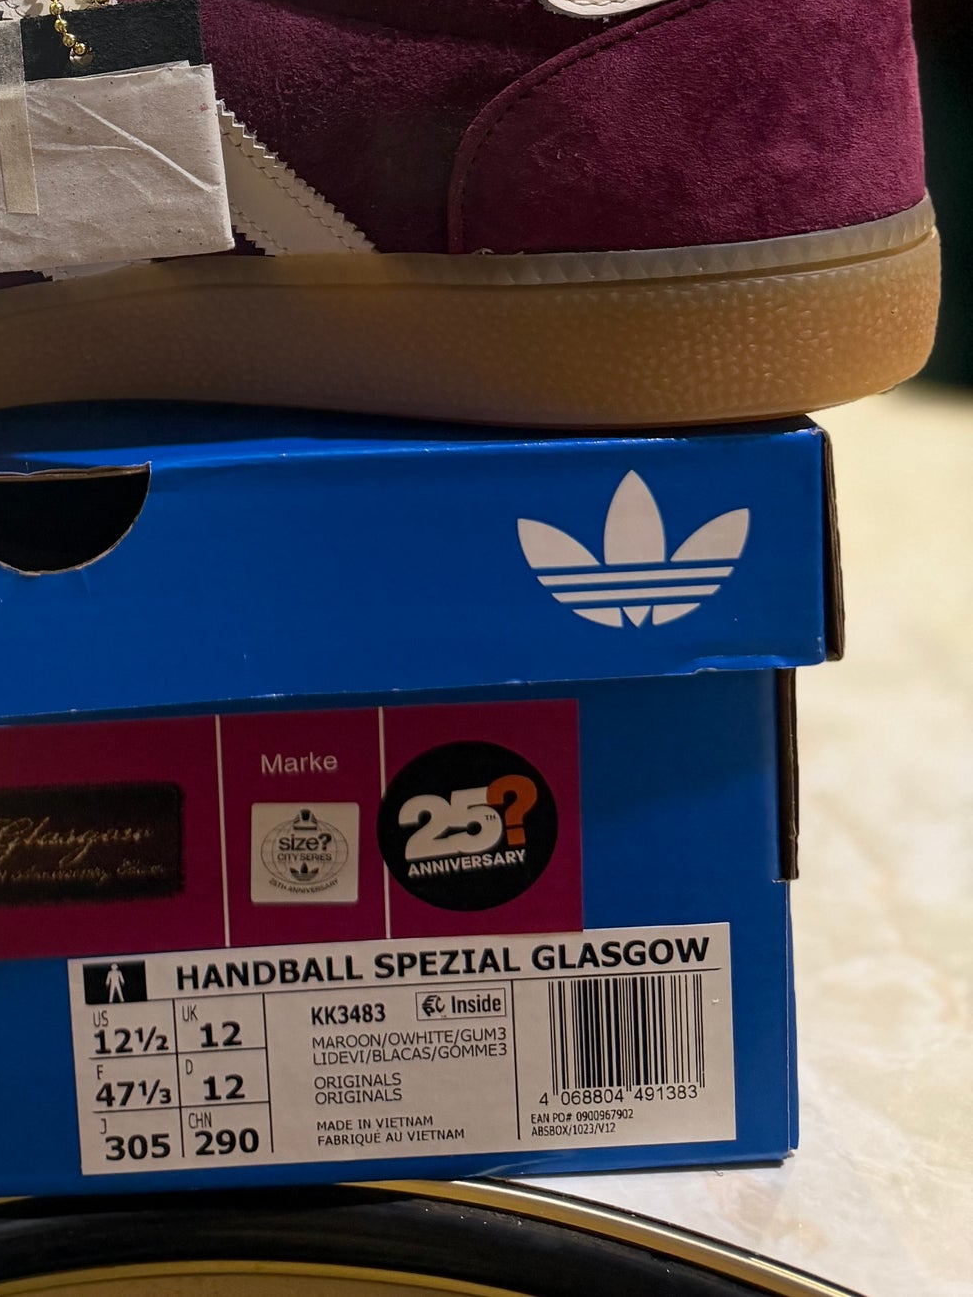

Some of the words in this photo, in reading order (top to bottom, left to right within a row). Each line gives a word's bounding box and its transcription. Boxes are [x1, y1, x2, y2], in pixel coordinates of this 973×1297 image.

[260, 751, 338, 775] Marke
[278, 832, 332, 852] size?
[277, 853, 300, 861] CITY
[300, 853, 332, 861] SERIES
[408, 849, 526, 877] ANNIVERSARY
[288, 877, 339, 894] ANNIVERSARY
[176, 955, 363, 991] HANDBALL
[374, 947, 520, 979] SPEZIAL
[531, 937, 709, 971] GLASGOW
[451, 994, 501, 1013] Inside
[92, 1010, 109, 1027] US
[182, 1005, 198, 1022] UK
[311, 1003, 386, 1025] KK3483
[200, 1021, 242, 1048] 12
[312, 1027, 507, 1049] MAROON/OWHITE/GUM3
[313, 1043, 507, 1065] LIDEVI/BLACAS/GOMME3
[96, 1064, 104, 1080] F
[185, 1059, 193, 1075] D
[203, 1074, 245, 1101] 12
[314, 1072, 402, 1089] ORIGINALS
[315, 1088, 403, 1105] ORIGINALS
[539, 1093, 548, 1106] 4
[561, 1087, 624, 1105] 068804
[634, 1084, 698, 1101] 491383
[188, 1112, 212, 1129] CHN
[317, 1120, 353, 1131] MADE
[358, 1119, 371, 1129] IN
[376, 1116, 433, 1128] VIETNAM
[531, 1113, 549, 1124] EAN
[553, 1113, 572, 1123] PO#
[576, 1109, 634, 1122] 0900967902
[100, 1118, 107, 1135] J
[531, 1122, 616, 1136] ABSBOX/1023/V12
[195, 1128, 259, 1155] 290
[386, 1131, 402, 1142] AU
[407, 1129, 465, 1141] VIETNAM
[105, 1133, 171, 1162] 305
